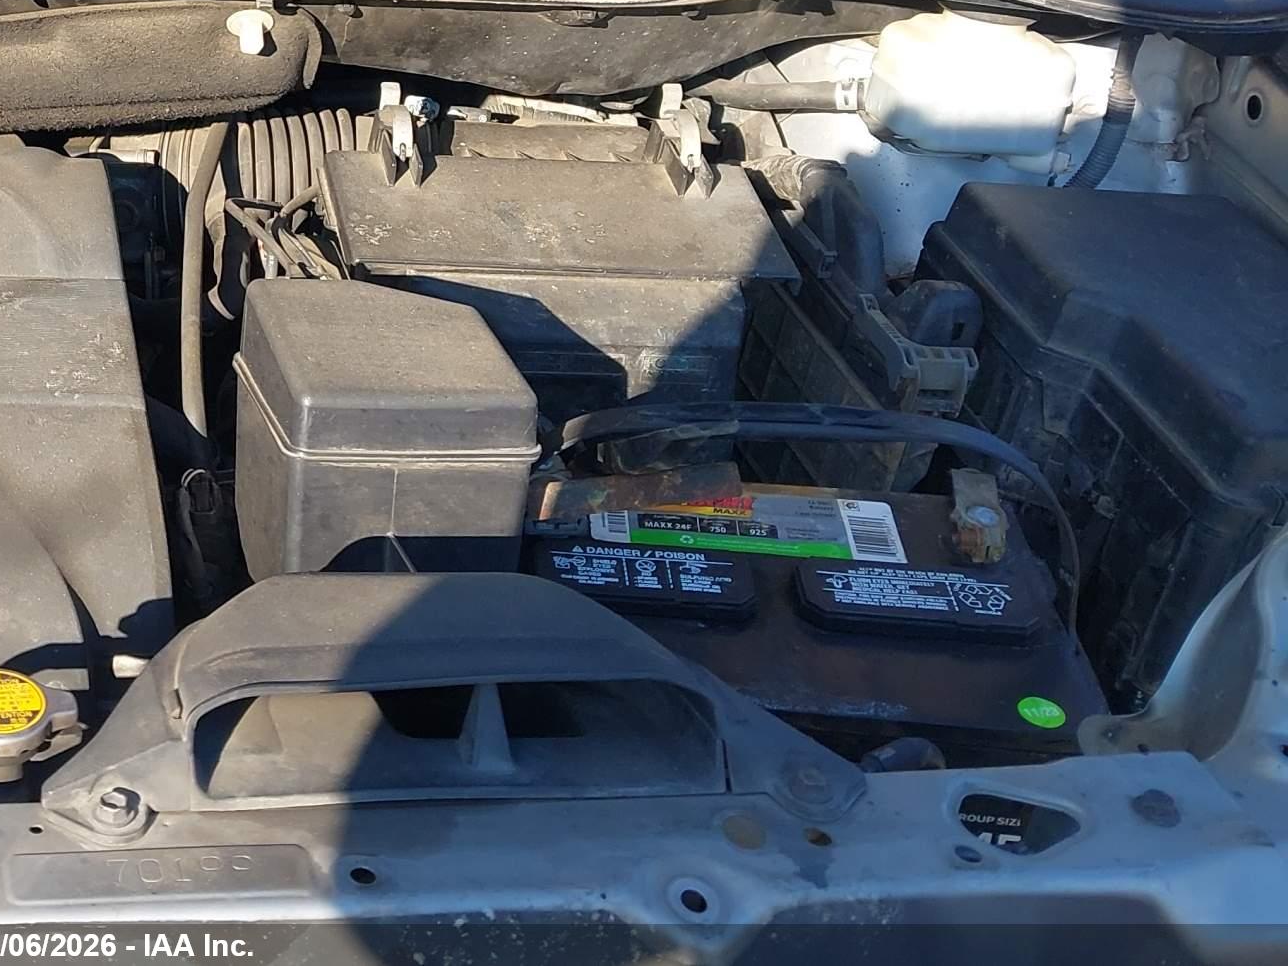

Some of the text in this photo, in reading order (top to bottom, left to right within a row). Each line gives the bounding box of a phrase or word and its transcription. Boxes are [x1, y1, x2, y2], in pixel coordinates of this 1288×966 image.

[644, 520, 673, 530] MAXX
[749, 528, 768, 537] 925
[586, 546, 641, 558] DANGER
[655, 550, 705, 561] POISON
[958, 812, 995, 823] ROUP
